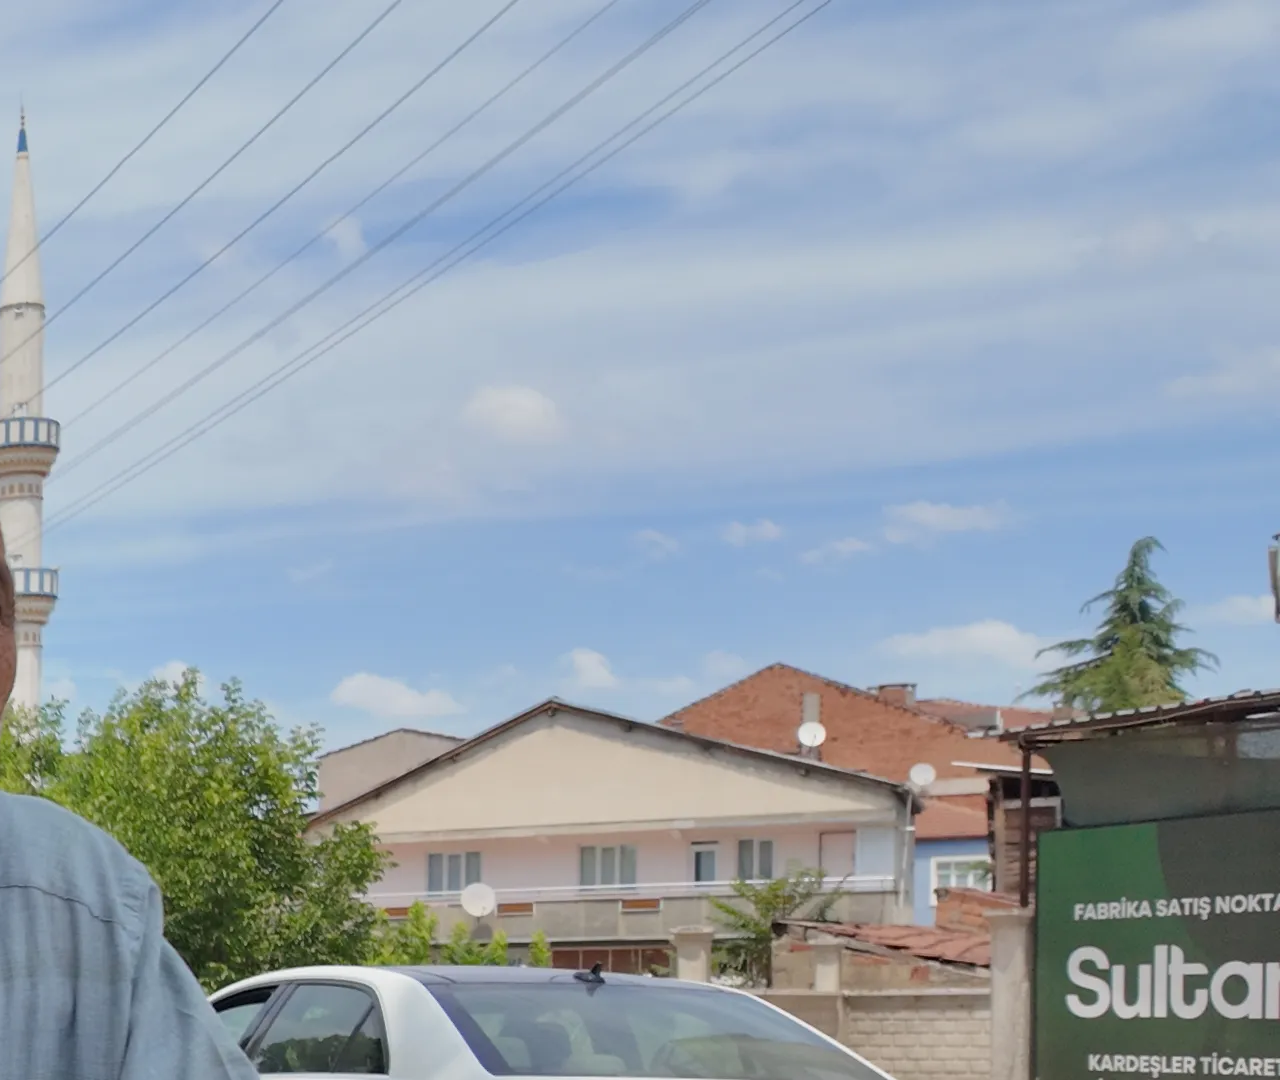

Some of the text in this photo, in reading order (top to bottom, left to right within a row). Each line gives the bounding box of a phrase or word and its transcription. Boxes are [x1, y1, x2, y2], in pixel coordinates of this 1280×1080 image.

[1073, 897, 1153, 921] FABRİKA
[1155, 896, 1212, 920] SATIŞ
[1087, 1053, 1196, 1078] KARDEŞLER
